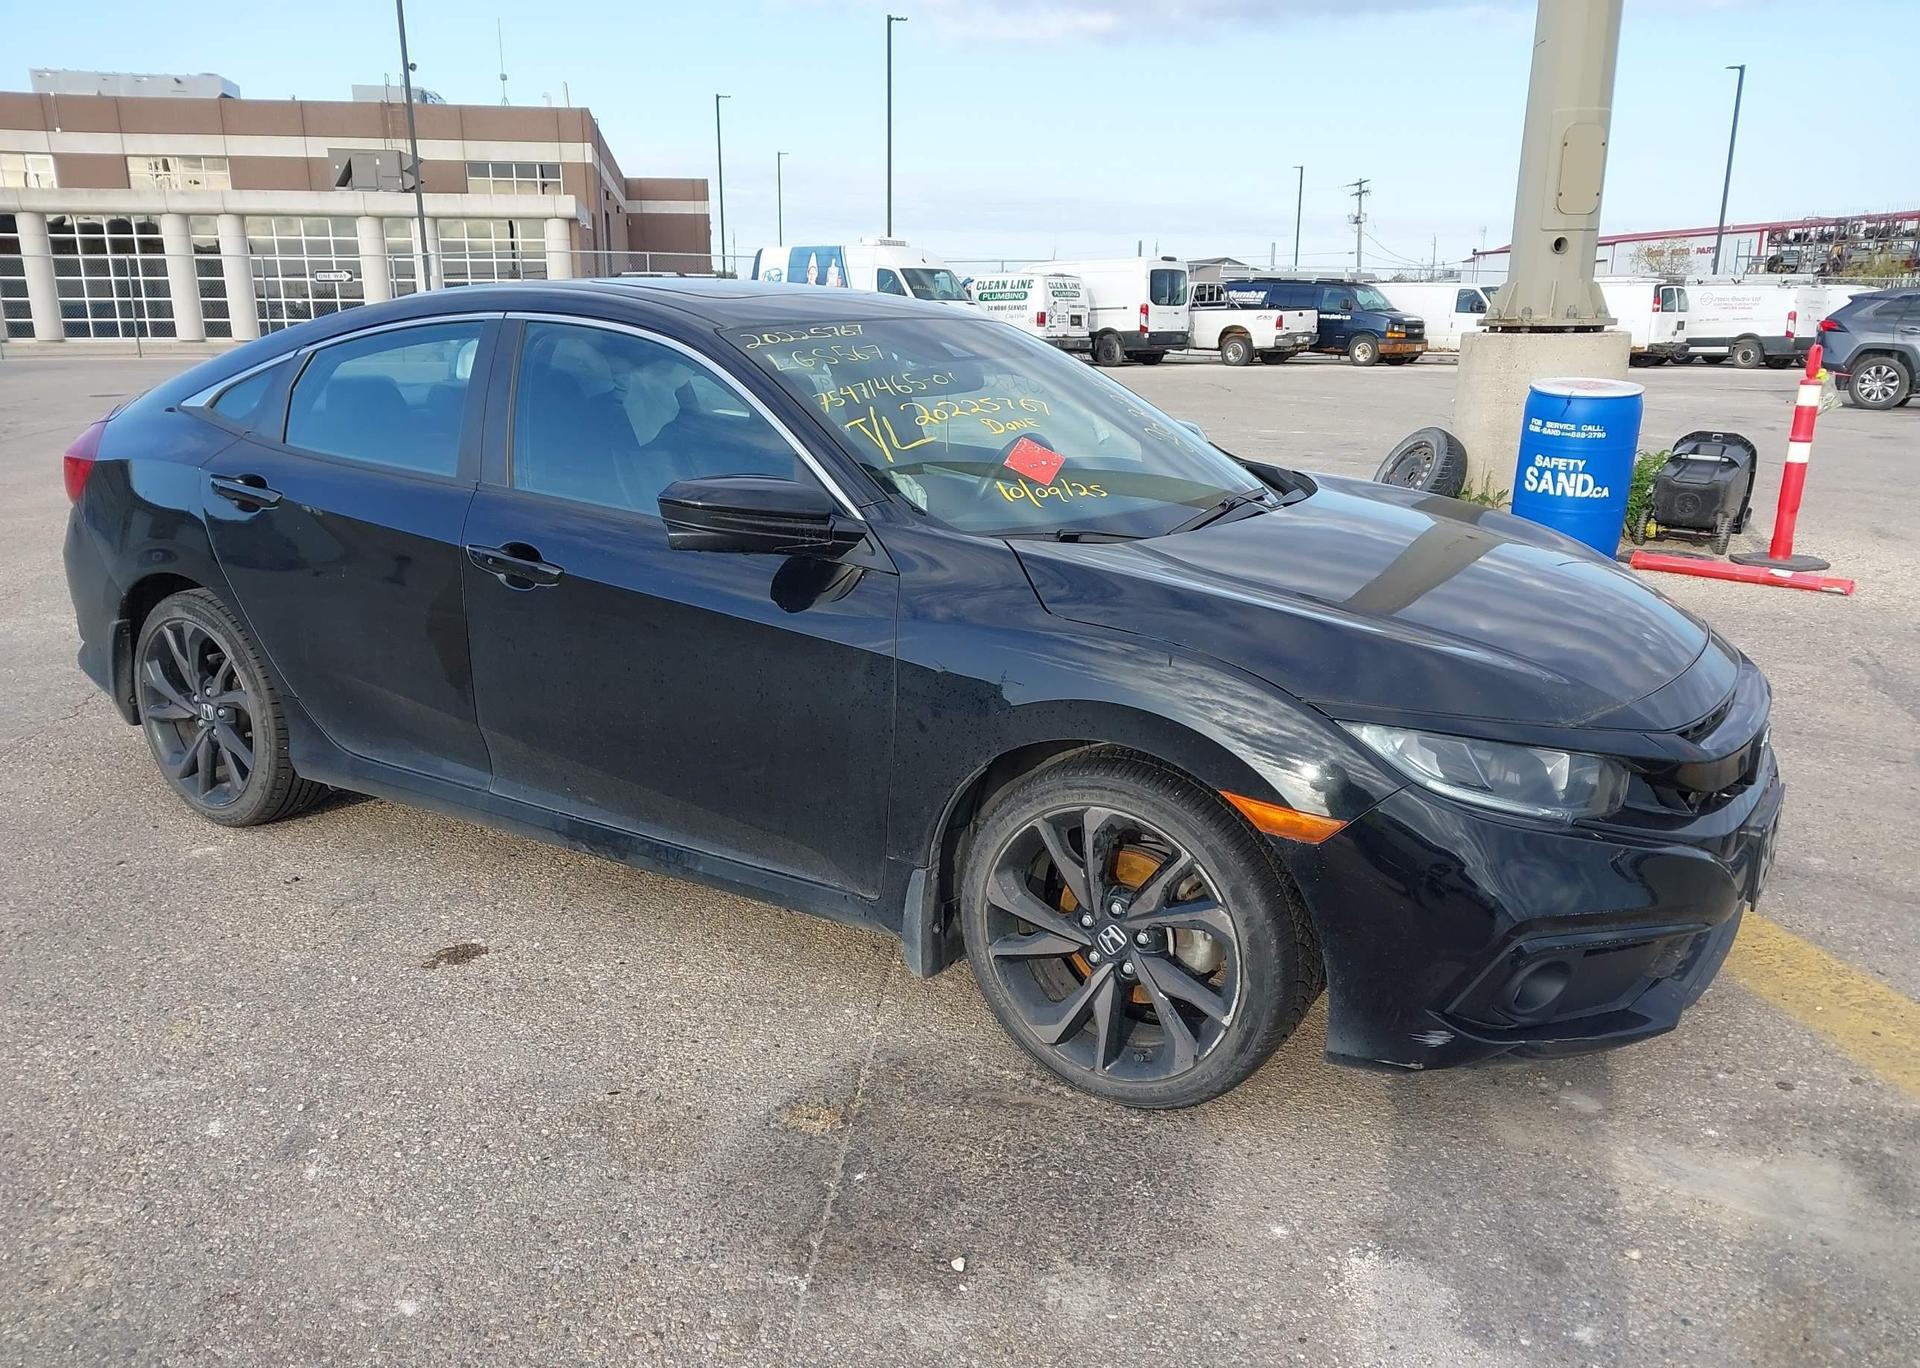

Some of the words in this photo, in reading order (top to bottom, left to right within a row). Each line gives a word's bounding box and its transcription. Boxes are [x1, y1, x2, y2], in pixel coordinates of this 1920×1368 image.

[1696, 246, 1717, 254] PART
[976, 279, 1009, 290] CLEAN
[1011, 279, 1034, 289] LINE
[1048, 281, 1068, 289] CLEAN
[982, 291, 1025, 301] PLUMBING
[1546, 420, 1577, 431] SERVICE
[1535, 454, 1586, 471] SAFETY
[996, 478, 1108, 508] 10/09/25
